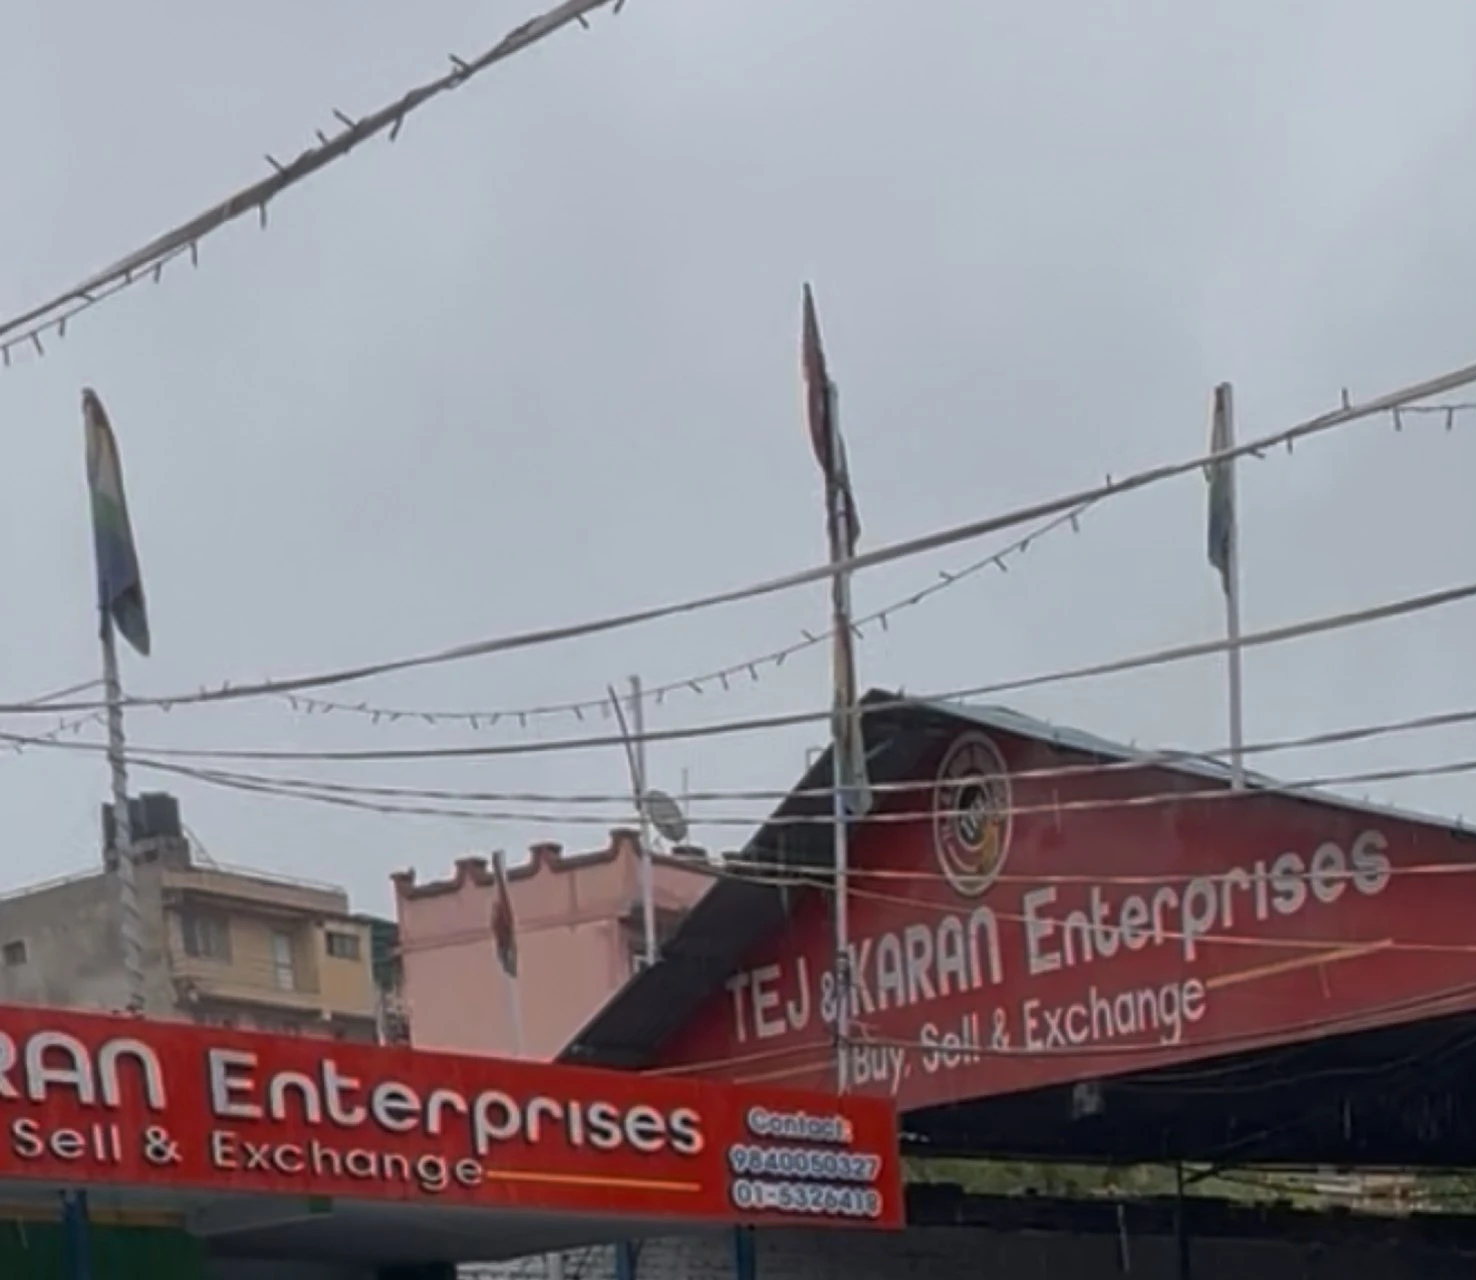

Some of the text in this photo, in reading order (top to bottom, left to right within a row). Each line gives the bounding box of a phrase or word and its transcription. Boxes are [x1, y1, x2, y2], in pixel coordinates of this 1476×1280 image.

[725, 829, 1391, 1043] TEJ & KARAN Enterprises
[920, 1014, 980, 1073] Sell
[991, 1007, 1011, 1052] &
[1023, 976, 1208, 1052] Exchange
[208, 1047, 706, 1155] Enterprises
[12, 1117, 484, 1192] Sell & Exchange
